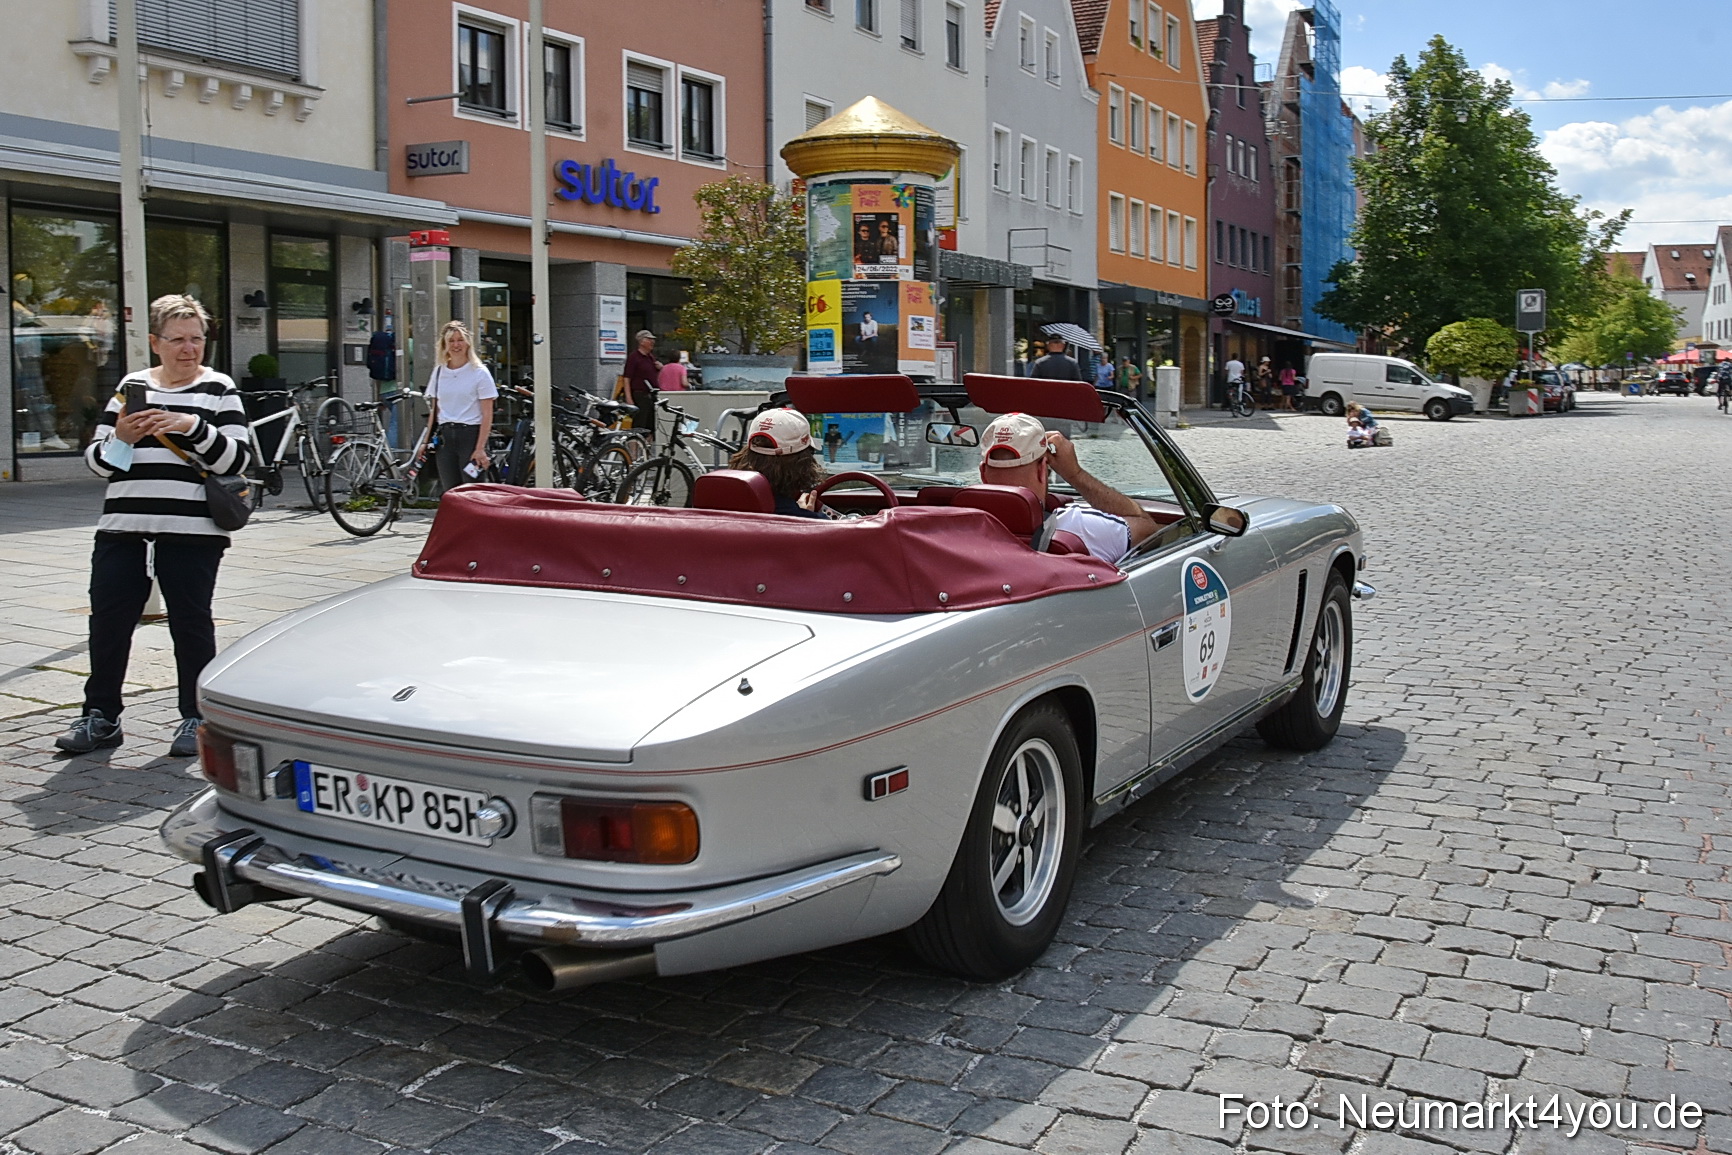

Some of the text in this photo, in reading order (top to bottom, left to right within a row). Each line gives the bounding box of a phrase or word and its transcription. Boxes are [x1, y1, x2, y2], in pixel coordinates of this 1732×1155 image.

[407, 147, 460, 170] sutor.
[554, 158, 661, 214] sutor.
[1200, 630, 1215, 663] 69
[313, 771, 485, 837] ER KP 85H
